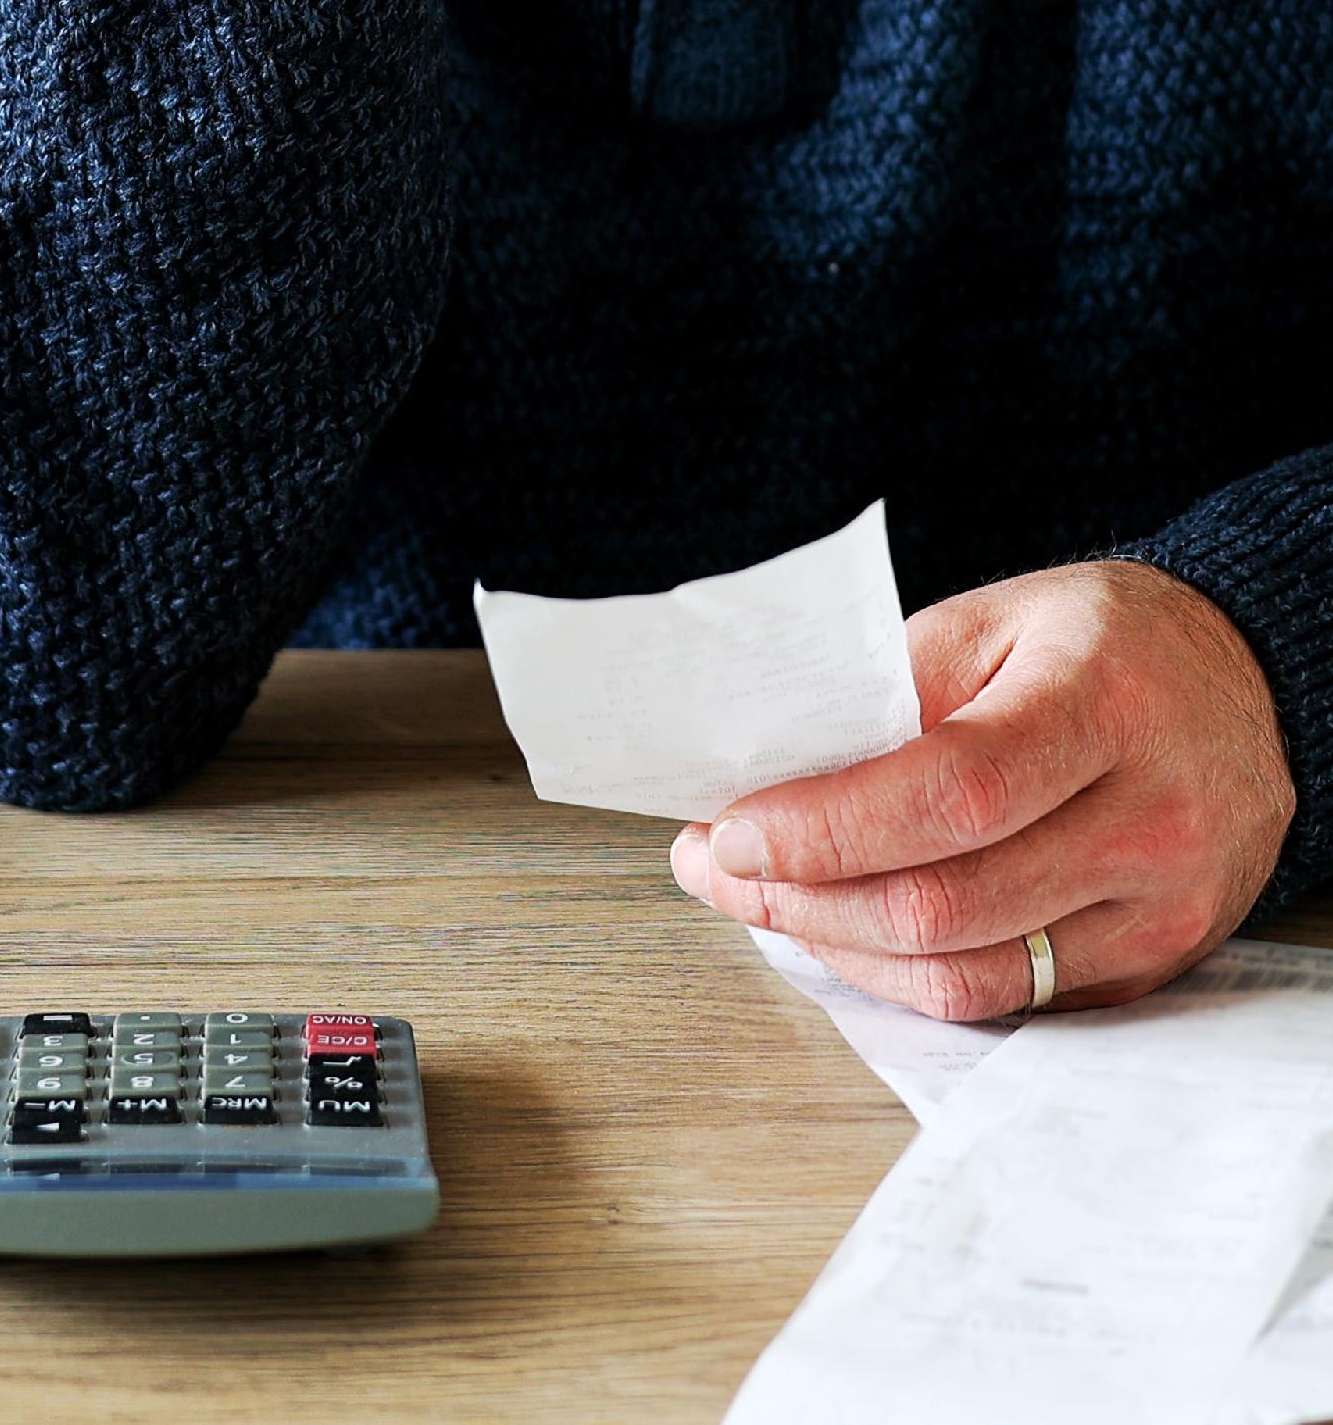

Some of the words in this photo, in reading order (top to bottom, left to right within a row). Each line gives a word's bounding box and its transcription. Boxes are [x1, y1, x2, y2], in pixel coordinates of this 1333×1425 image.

[226, 1014, 249, 1024] 0
[312, 1015, 367, 1025] ON/AC
[43, 1035, 64, 1046] 3
[133, 1033, 155, 1045] 2
[230, 1034, 242, 1045] 1
[316, 1035, 368, 1046] C/CE
[39, 1055, 63, 1067] 6
[133, 1053, 154, 1065] 5
[224, 1054, 249, 1065] 4
[37, 1077, 62, 1088] 9
[131, 1076, 154, 1088] 8
[225, 1076, 246, 1088] 7
[324, 1076, 363, 1089] %
[117, 1098, 167, 1110] M+
[211, 1097, 268, 1110] MRC
[319, 1100, 370, 1112] MU
